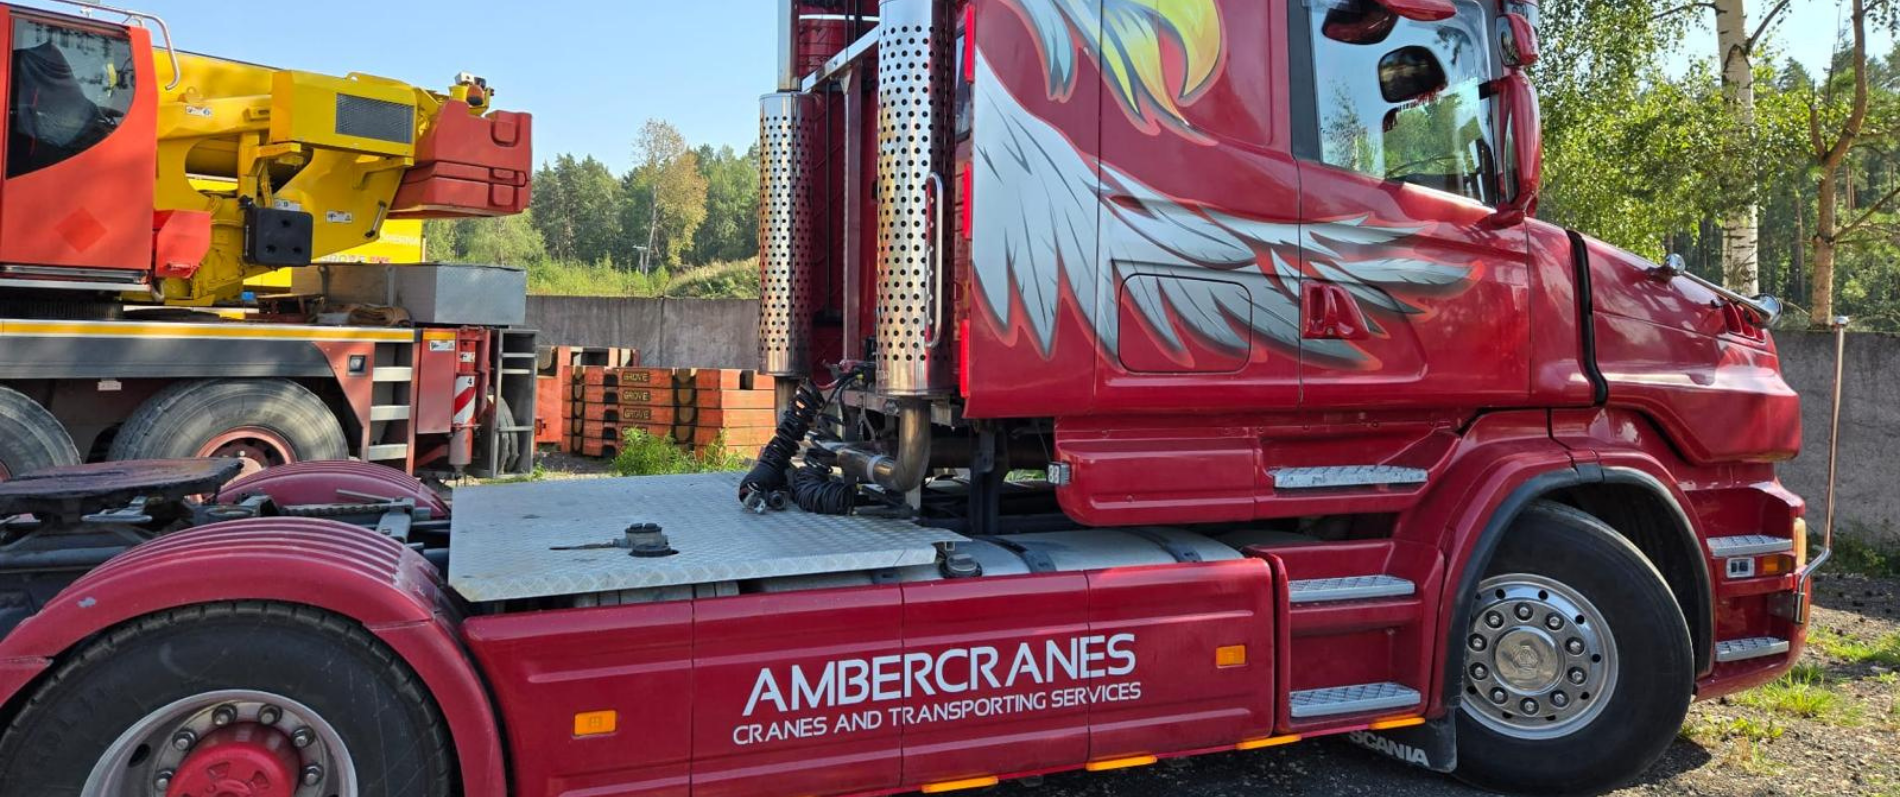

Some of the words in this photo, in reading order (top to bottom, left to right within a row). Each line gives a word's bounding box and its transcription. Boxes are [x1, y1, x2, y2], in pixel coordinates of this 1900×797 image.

[742, 633, 1136, 716] AMBERCRANES
[733, 717, 828, 745] CRANES
[833, 710, 882, 734] AND
[888, 691, 1047, 726] TRANSPORTING
[1051, 681, 1142, 708] SERVICES
[1349, 729, 1431, 768] SCANIA
